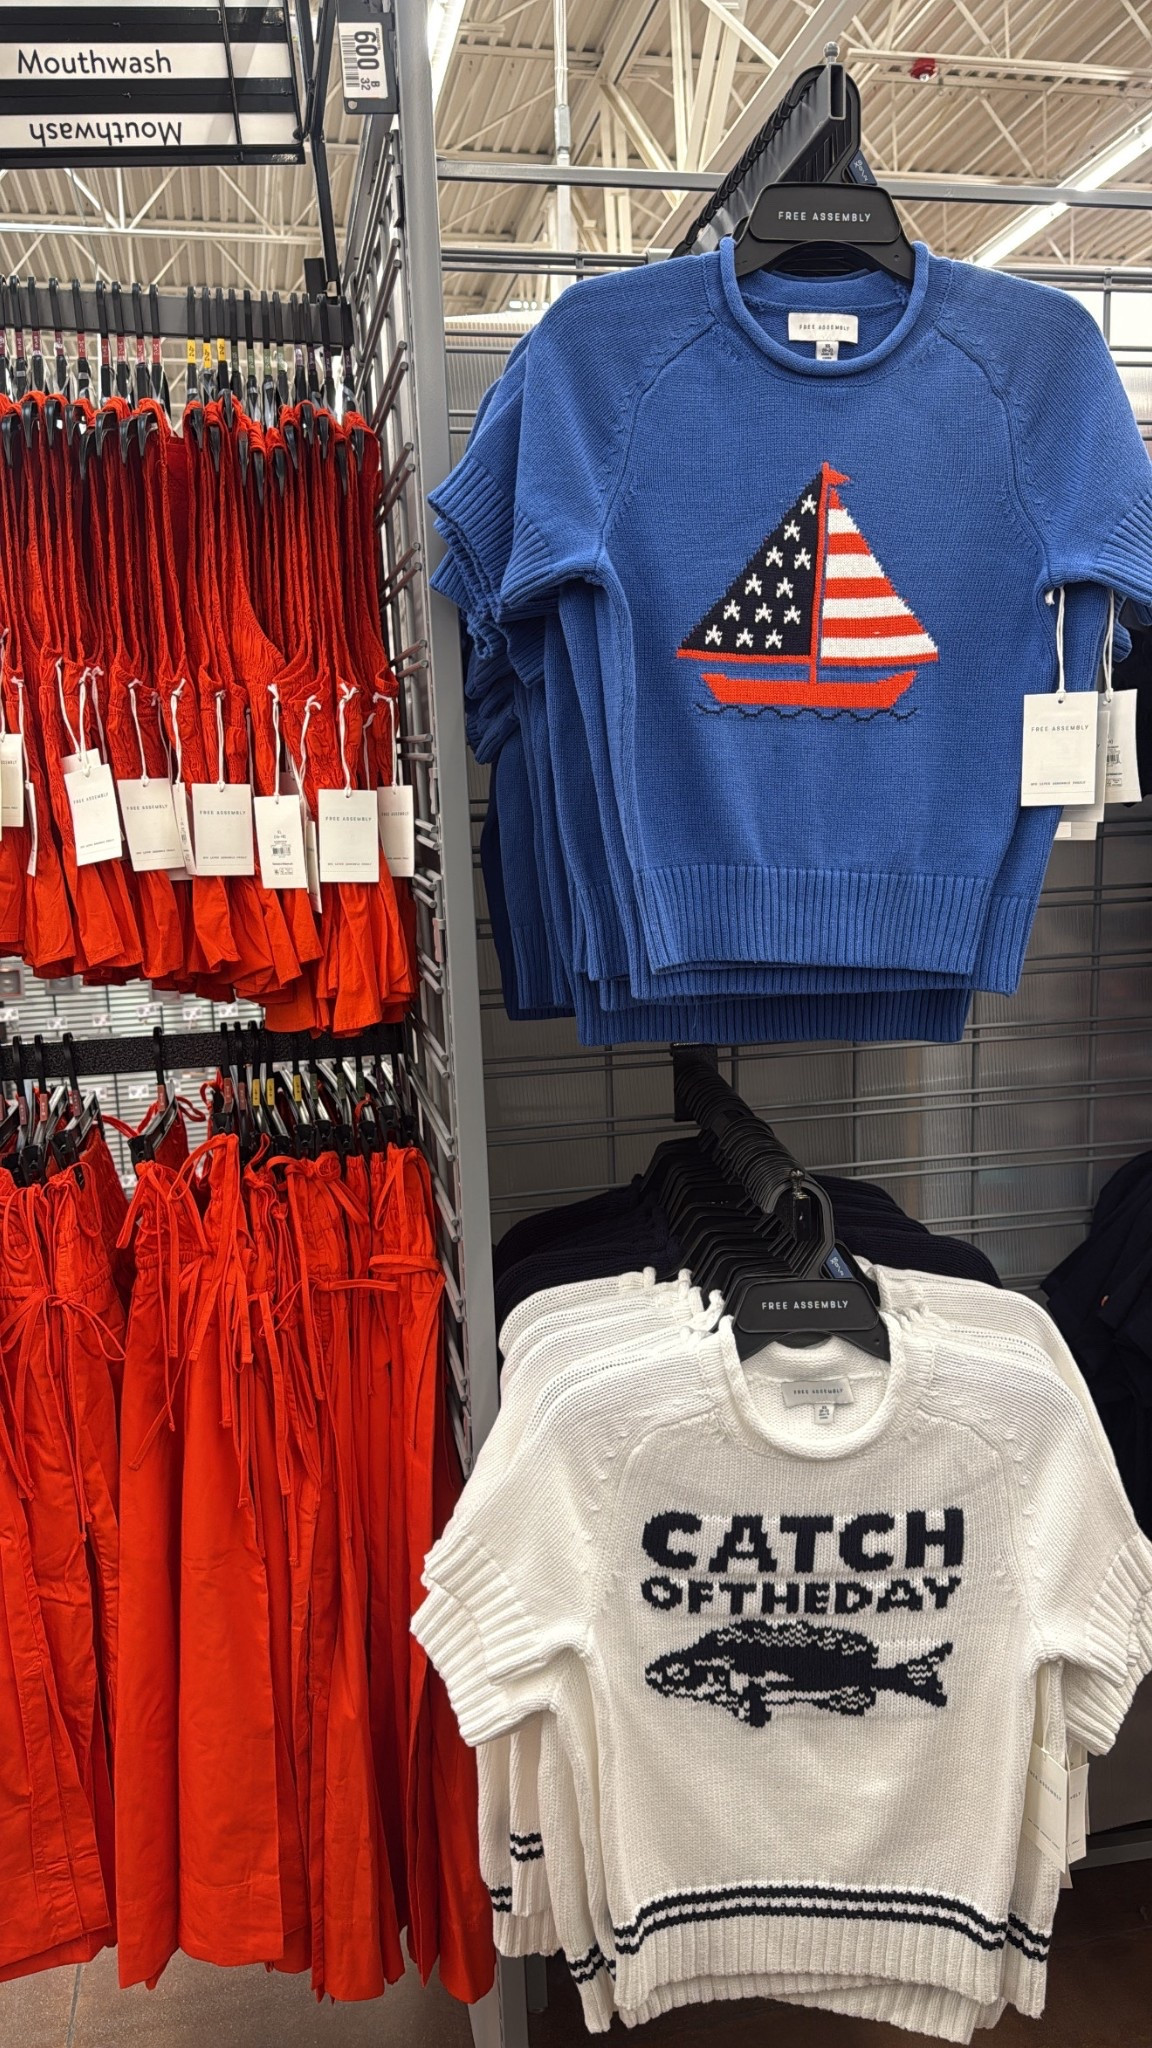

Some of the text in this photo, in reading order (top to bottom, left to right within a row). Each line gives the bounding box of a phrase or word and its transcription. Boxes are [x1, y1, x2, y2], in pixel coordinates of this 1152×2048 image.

[353, 30, 380, 71] 600
[17, 49, 172, 75] Mouthwash
[360, 77, 371, 91] 32
[371, 80, 381, 88] B
[29, 121, 182, 147] Mouthwash
[778, 211, 871, 222] FREE ASSEMBLY
[818, 324, 850, 332] ASSEMBLY
[762, 1300, 849, 1310] FREE ASSEMBLY
[642, 1507, 964, 1574] CATCH
